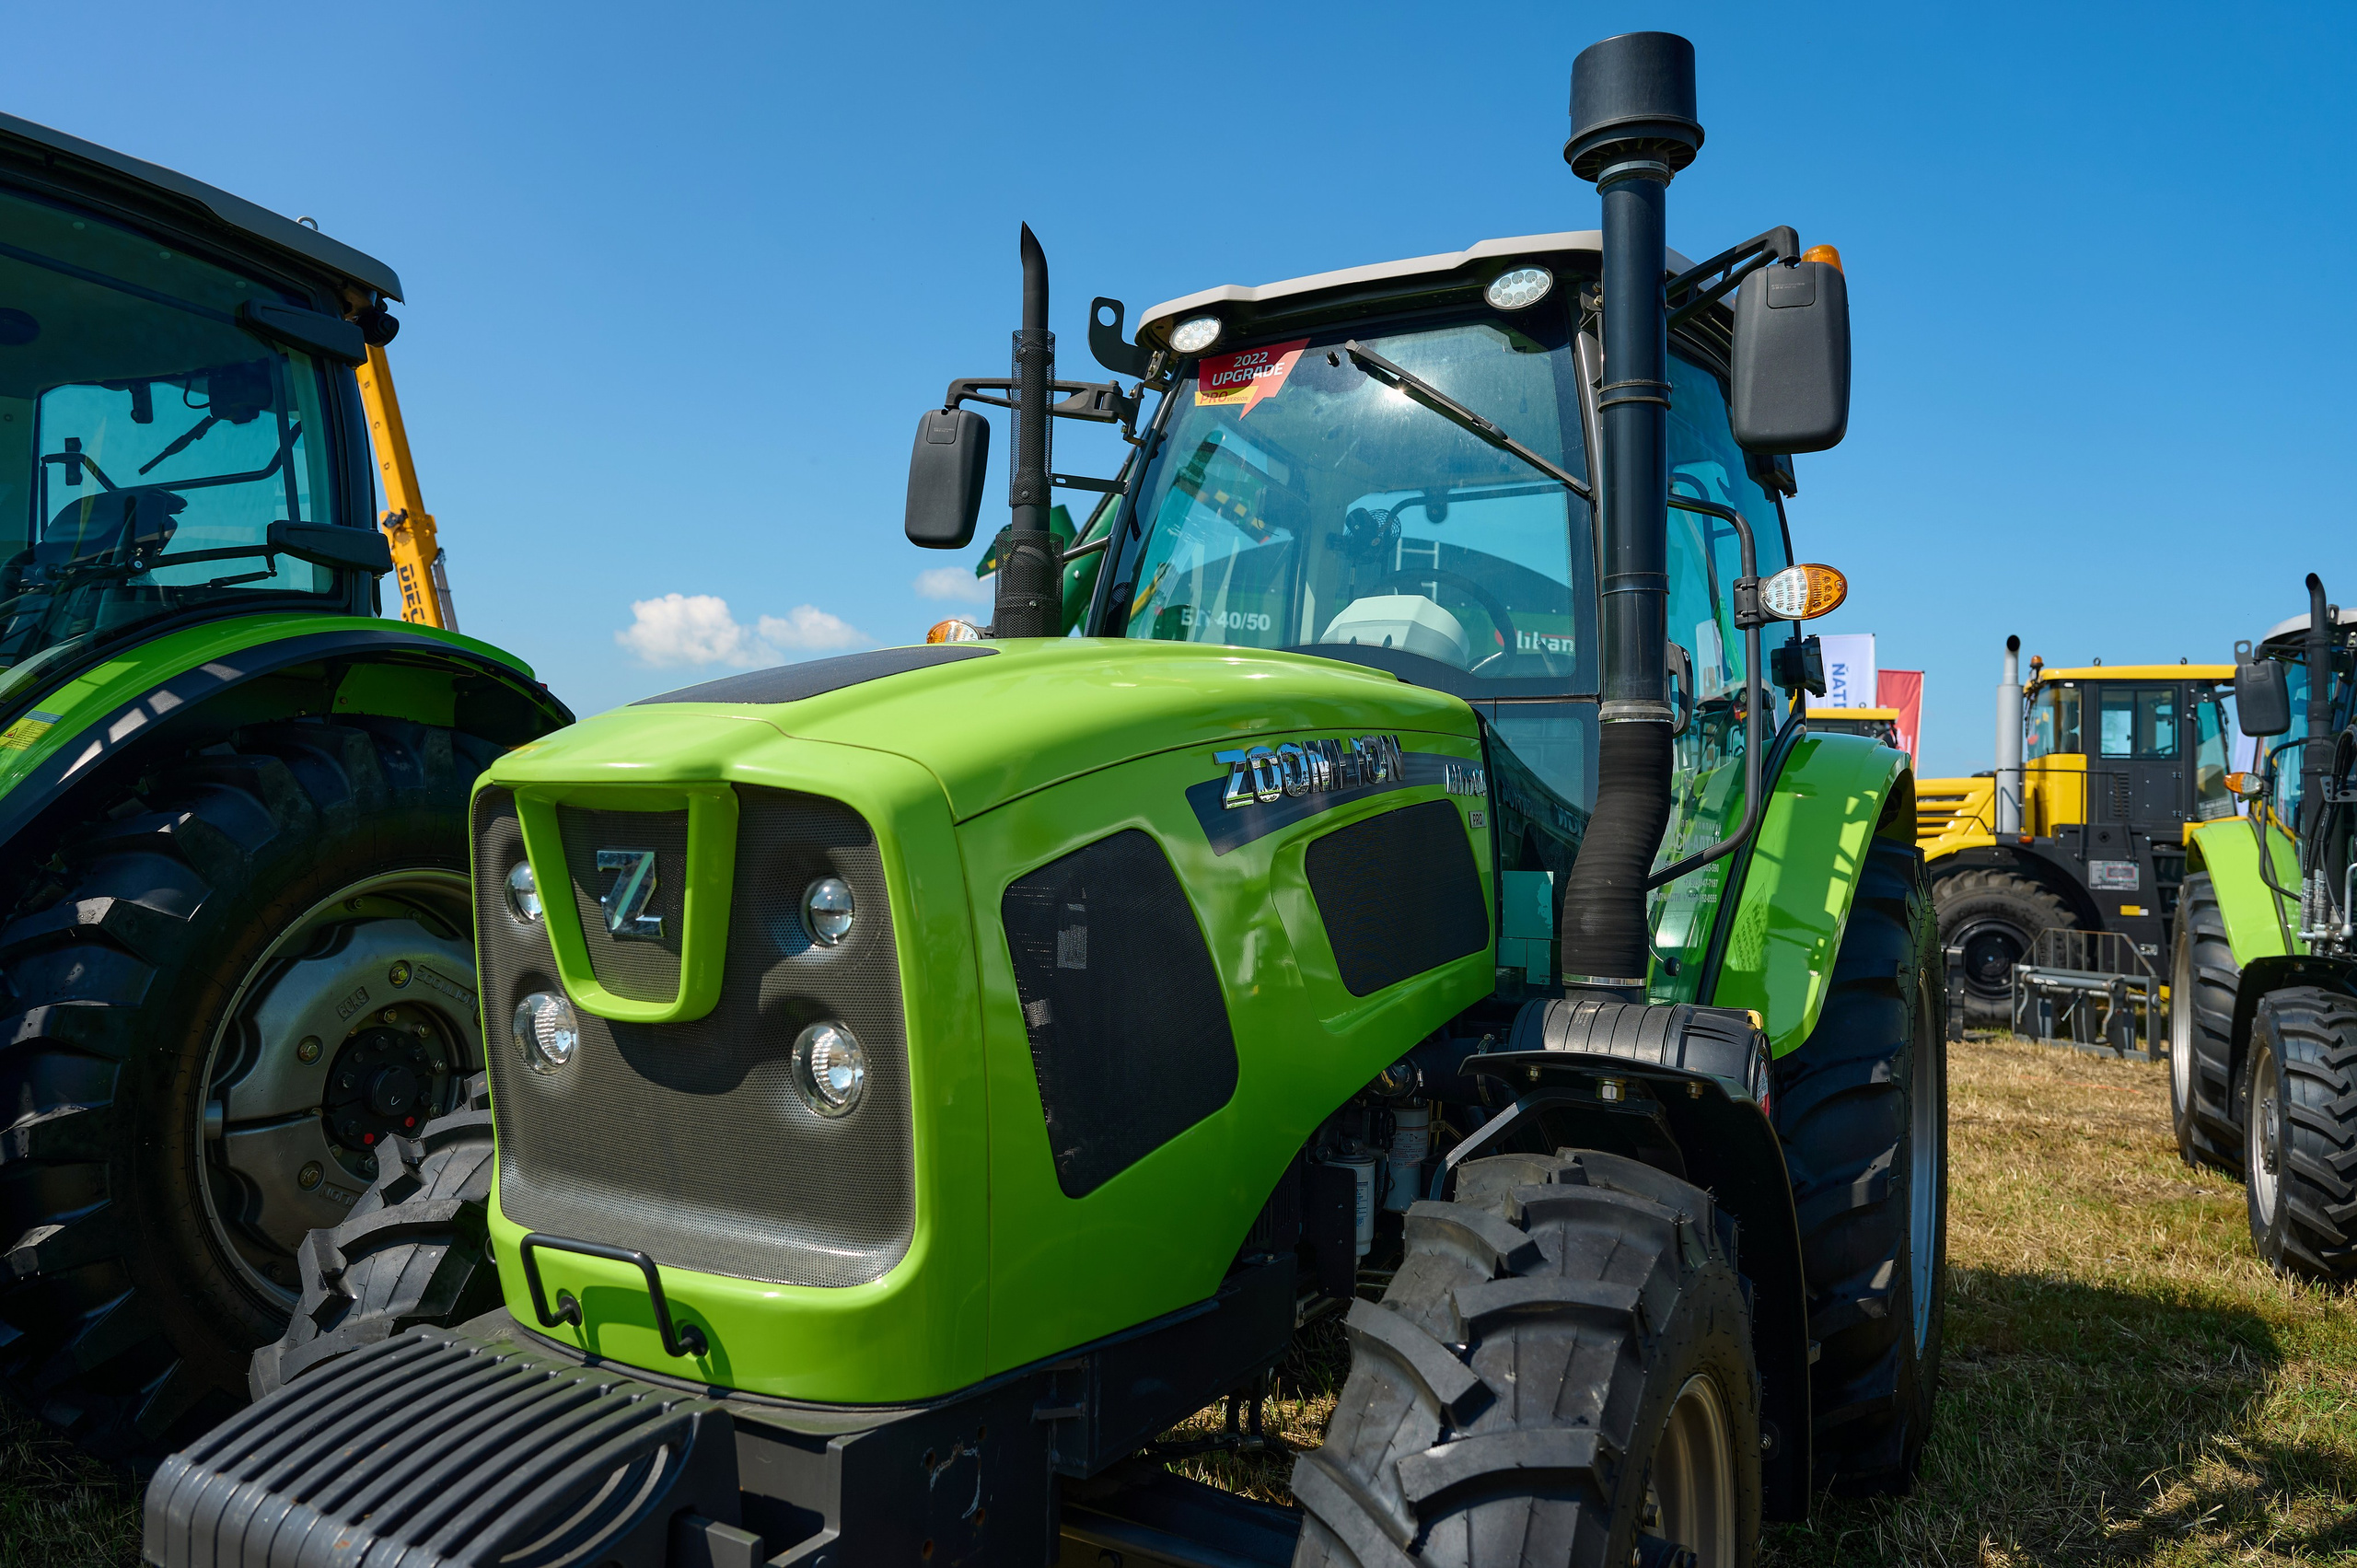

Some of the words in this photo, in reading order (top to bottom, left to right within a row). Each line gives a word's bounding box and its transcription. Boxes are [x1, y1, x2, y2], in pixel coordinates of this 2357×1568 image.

[1234, 352, 1269, 367] 2022
[1212, 362, 1285, 386] UPGRADE
[1200, 390, 1228, 404] PRO
[400, 563, 425, 624] DIEC
[1213, 734, 1405, 810] ZOOMLION
[1472, 813, 1483, 826] PRO
[414, 968, 478, 1010] ZOOMLION
